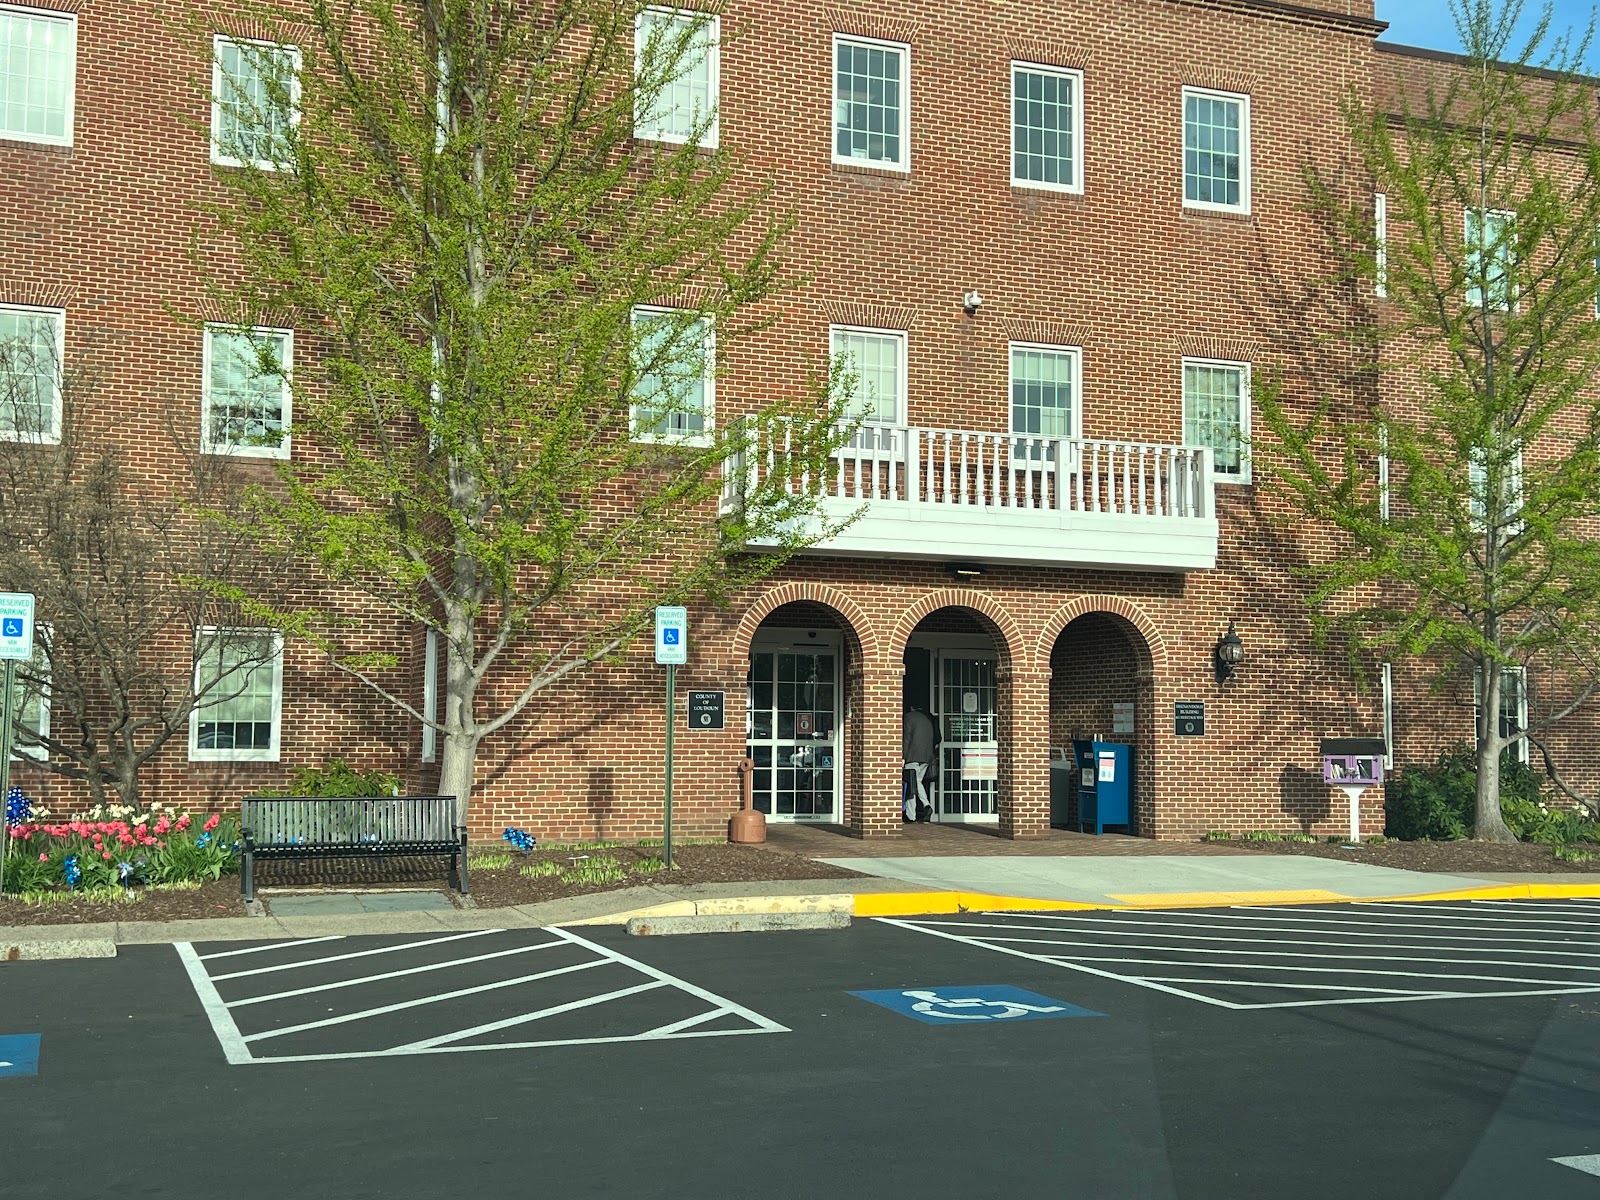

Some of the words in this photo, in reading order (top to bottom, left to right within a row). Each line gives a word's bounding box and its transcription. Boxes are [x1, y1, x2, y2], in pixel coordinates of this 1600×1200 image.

[0, 598, 30, 607] RESERVED
[0, 608, 27, 616] PARKING
[661, 619, 682, 627] PARKING
